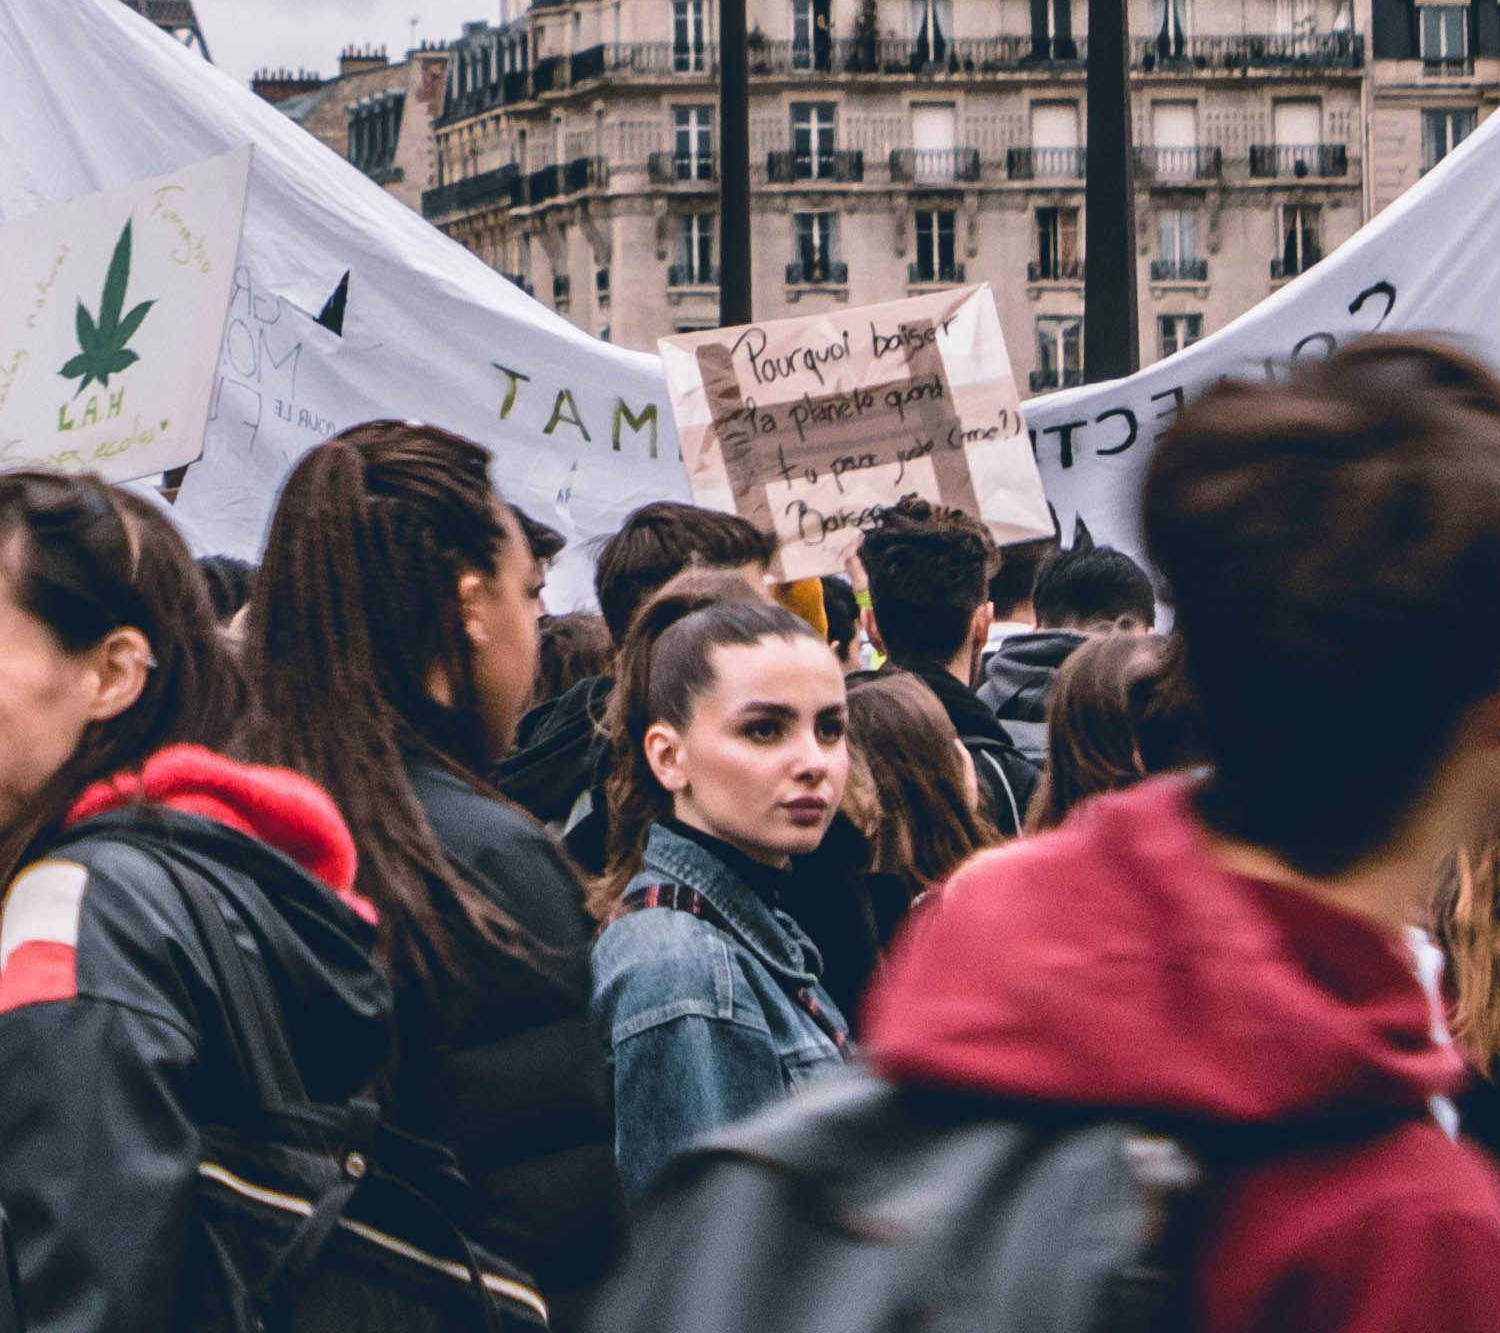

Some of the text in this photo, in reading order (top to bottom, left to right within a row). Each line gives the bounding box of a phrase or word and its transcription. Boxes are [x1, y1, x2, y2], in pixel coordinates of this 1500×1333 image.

[731, 314, 958, 385] Pourquoi baiser
[742, 397, 776, 434] la
